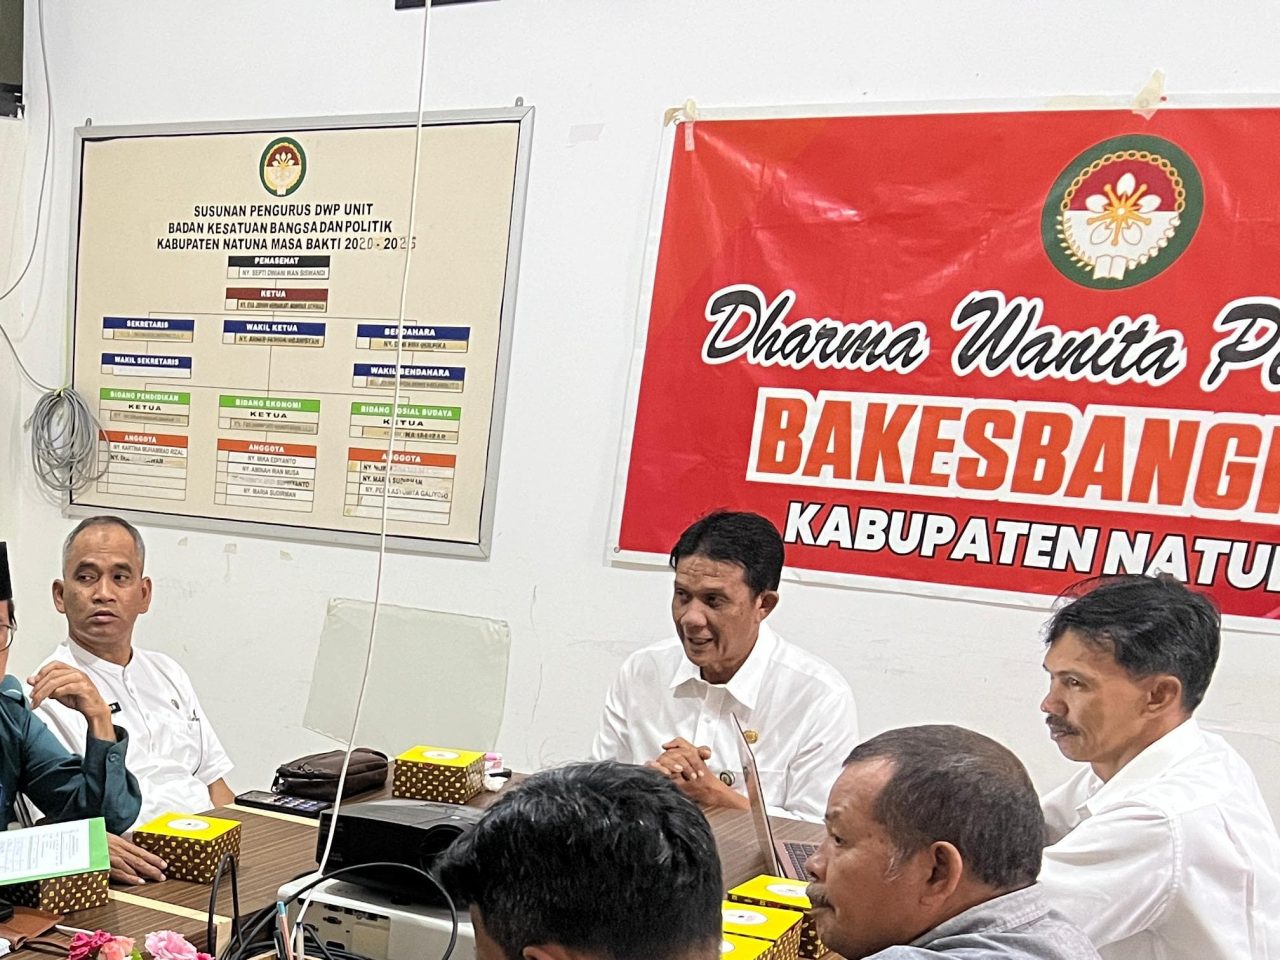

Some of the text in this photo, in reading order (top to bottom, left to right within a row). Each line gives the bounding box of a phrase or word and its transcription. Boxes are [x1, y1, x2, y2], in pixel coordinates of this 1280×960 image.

[194, 203, 374, 218] SUSUNAN PENGURUS DWP UNIT
[168, 222, 204, 234] BADAN
[207, 222, 268, 234] KESATUAN
[345, 220, 393, 233] POLITIK
[157, 238, 220, 250] KABUPATEN
[223, 238, 268, 250] NATUNA
[271, 238, 303, 250] MASA
[306, 237, 341, 250] BAKTI
[345, 237, 374, 250] 2020
[254, 257, 300, 265] PENASEHAT
[260, 290, 287, 298] KETUA
[126, 320, 169, 329] SEKRETARIS
[246, 323, 298, 332] WAKIL KETUA
[706, 286, 1280, 386] Dharma Wanita P
[114, 356, 180, 366] WAKIL SEKRETARIS
[370, 366, 450, 377] WAKIL BENDAHARA
[110, 391, 179, 401] BIDANG PENDIDIKAN
[235, 399, 302, 408] BIDANG EKONOMI
[361, 405, 453, 417] BIDANG OSIAL BUDAYA
[124, 434, 157, 443] ANGGOTA
[248, 444, 285, 453] ANGGOTA
[783, 501, 1098, 574] KABUPATEN
